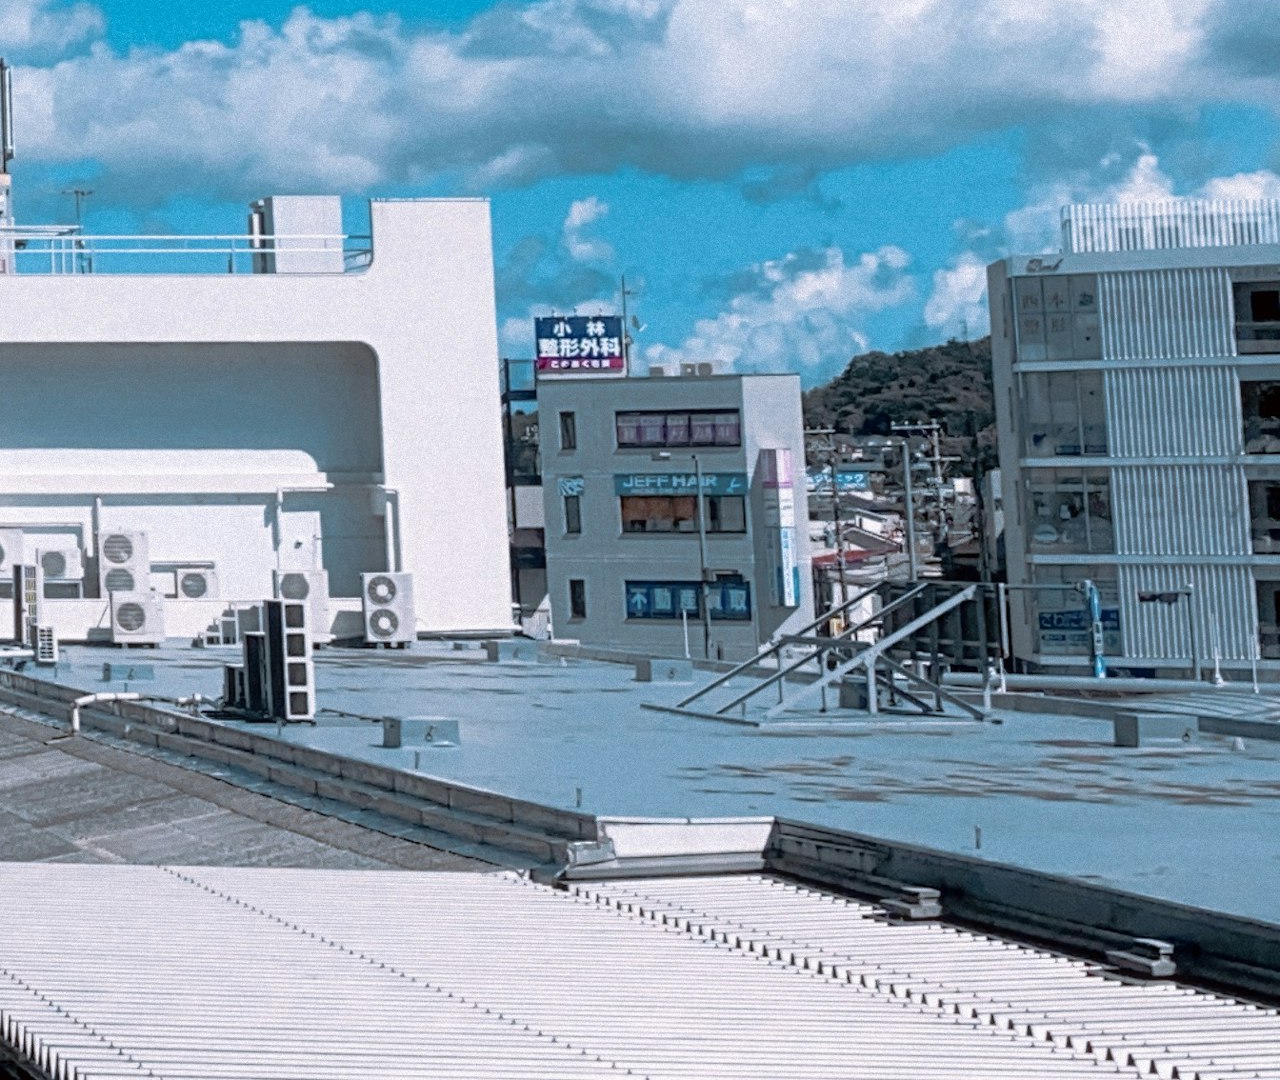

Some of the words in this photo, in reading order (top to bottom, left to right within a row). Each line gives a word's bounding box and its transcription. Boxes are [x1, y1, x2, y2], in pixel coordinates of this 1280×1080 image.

[553, 321, 606, 337] 小林
[538, 337, 620, 358] 整形外科
[623, 475, 668, 488] JEFF
[672, 474, 717, 488] HAIR
